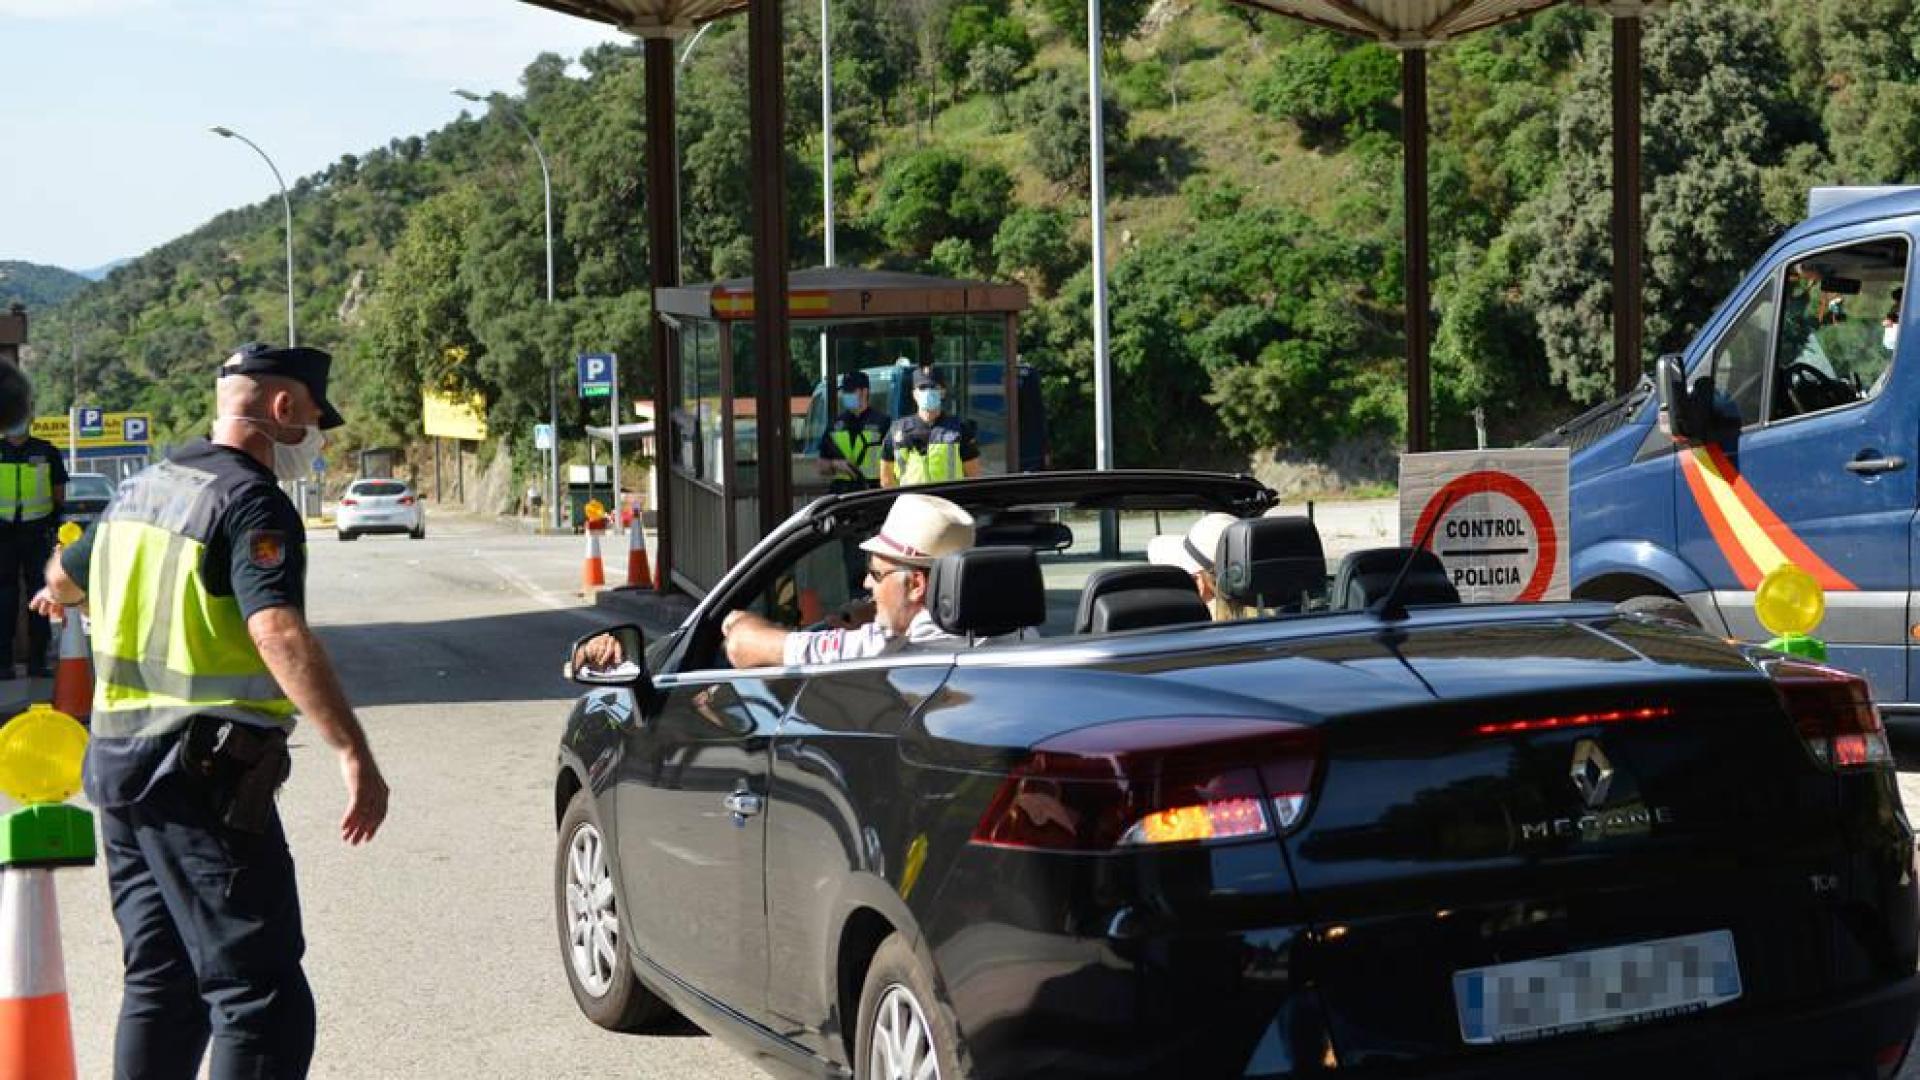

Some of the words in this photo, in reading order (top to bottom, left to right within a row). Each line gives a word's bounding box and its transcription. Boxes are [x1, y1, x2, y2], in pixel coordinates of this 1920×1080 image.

[587, 358, 605, 379] P
[84, 410, 99, 426] P
[126, 419, 145, 440] P
[1446, 517, 1525, 538] CONTROL
[1454, 566, 1521, 586] POLICIA
[1521, 807, 1675, 839] MEGANE
